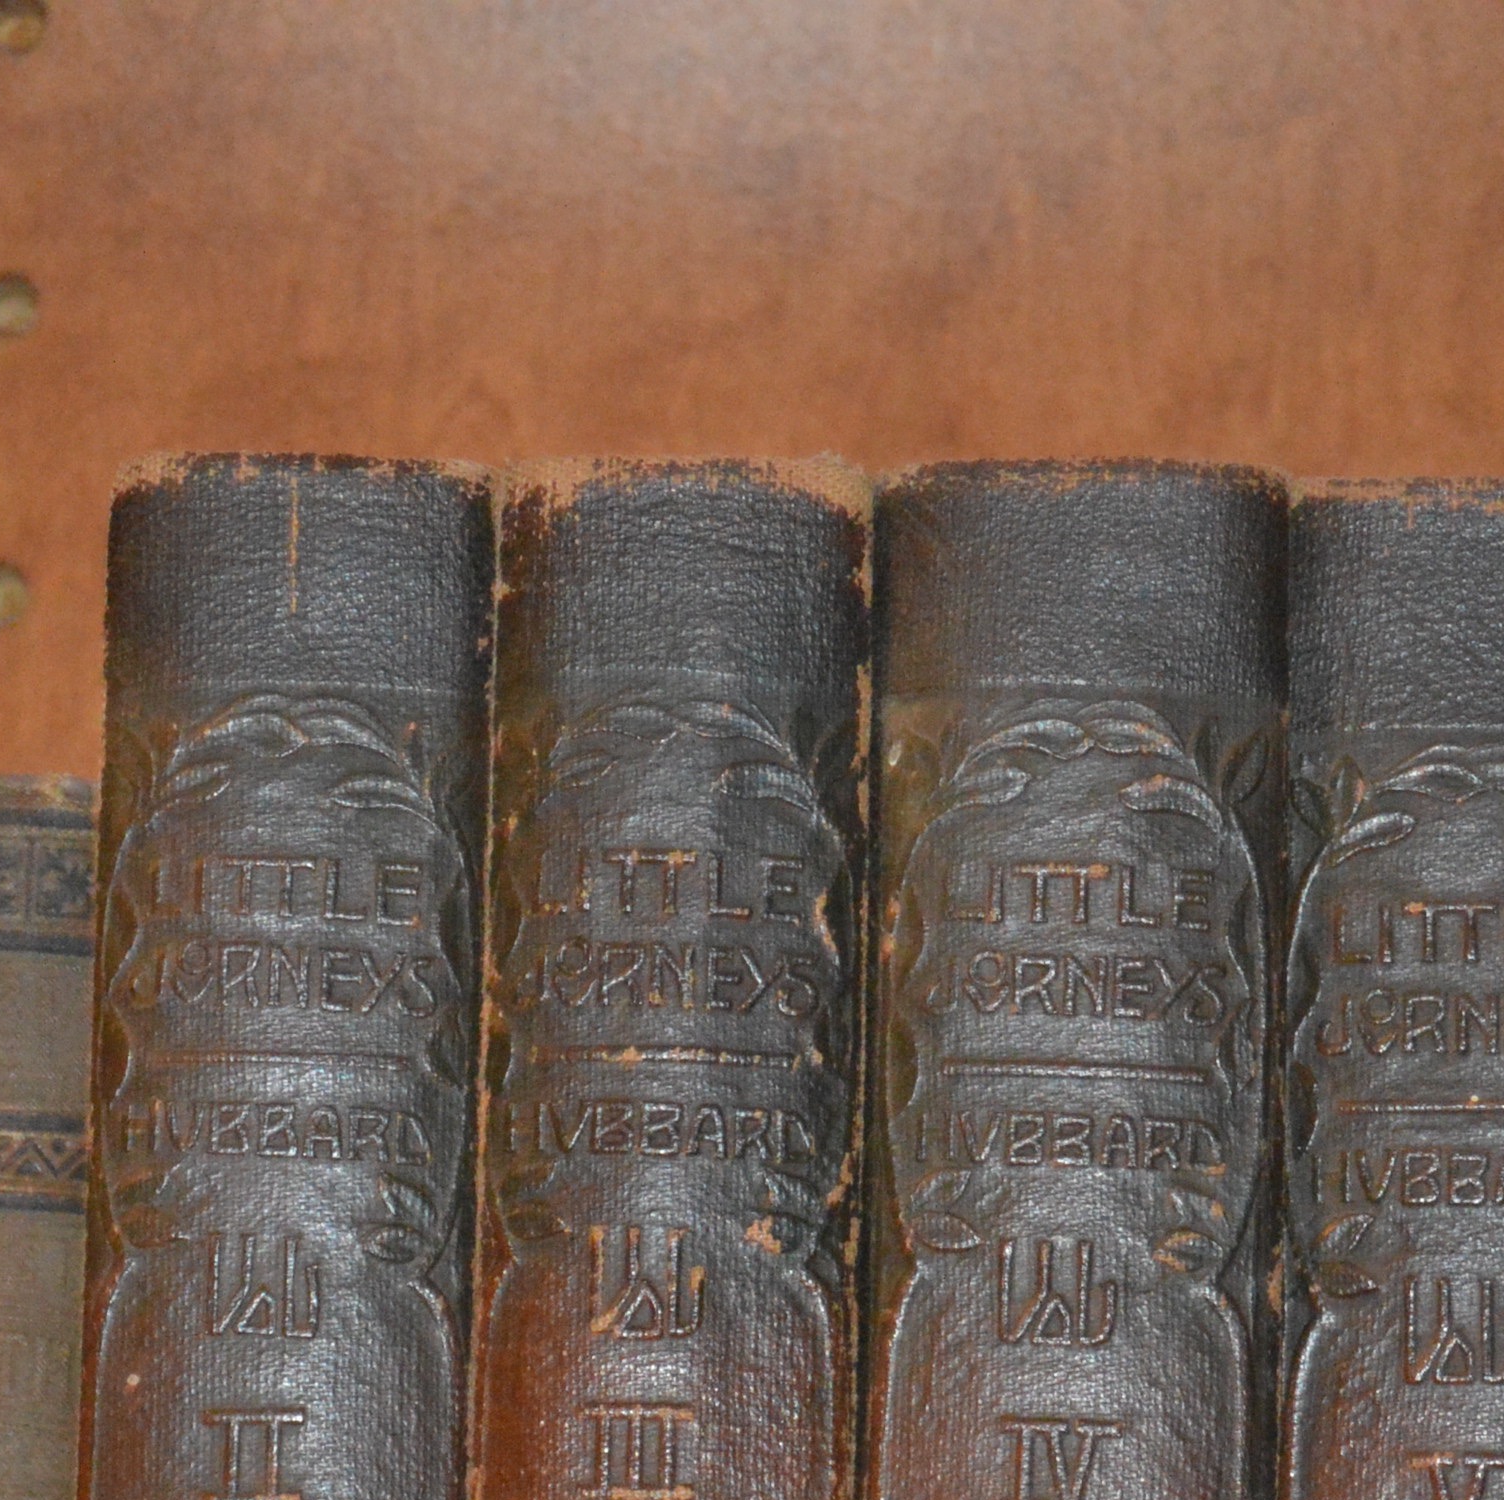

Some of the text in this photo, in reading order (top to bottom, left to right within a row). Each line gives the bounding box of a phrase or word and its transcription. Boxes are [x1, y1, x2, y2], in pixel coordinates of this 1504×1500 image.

[149, 855, 422, 928] LITTLE
[529, 849, 804, 925] LITTLE
[946, 862, 1214, 932] LITTLE
